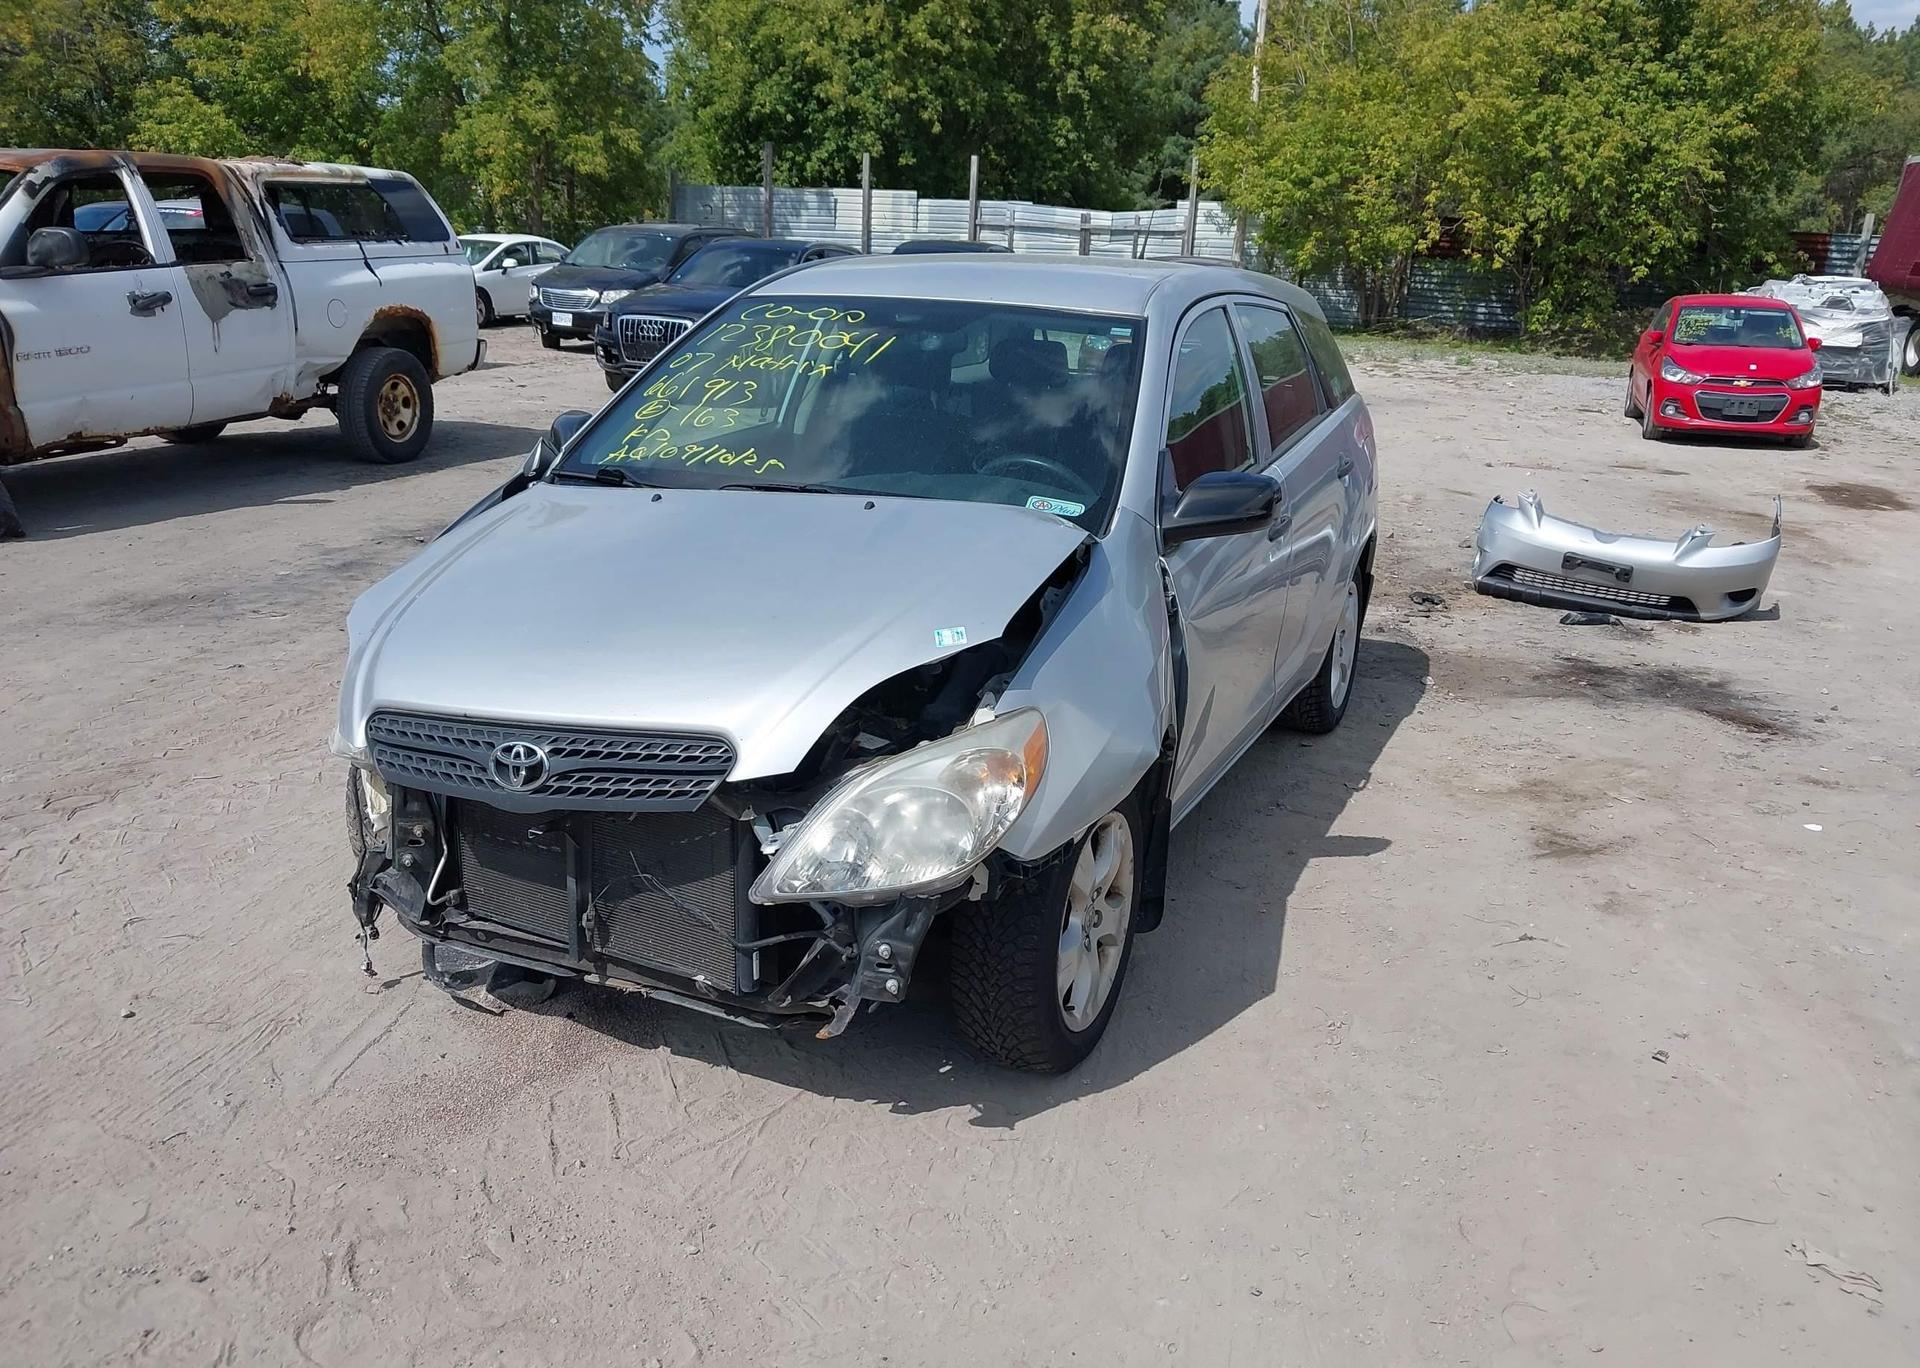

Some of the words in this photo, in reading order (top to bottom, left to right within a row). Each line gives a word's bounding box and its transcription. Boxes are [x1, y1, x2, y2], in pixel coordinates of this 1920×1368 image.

[697, 322, 897, 365] 12380041
[669, 352, 716, 374] 07
[1050, 504, 1079, 515] Plus
